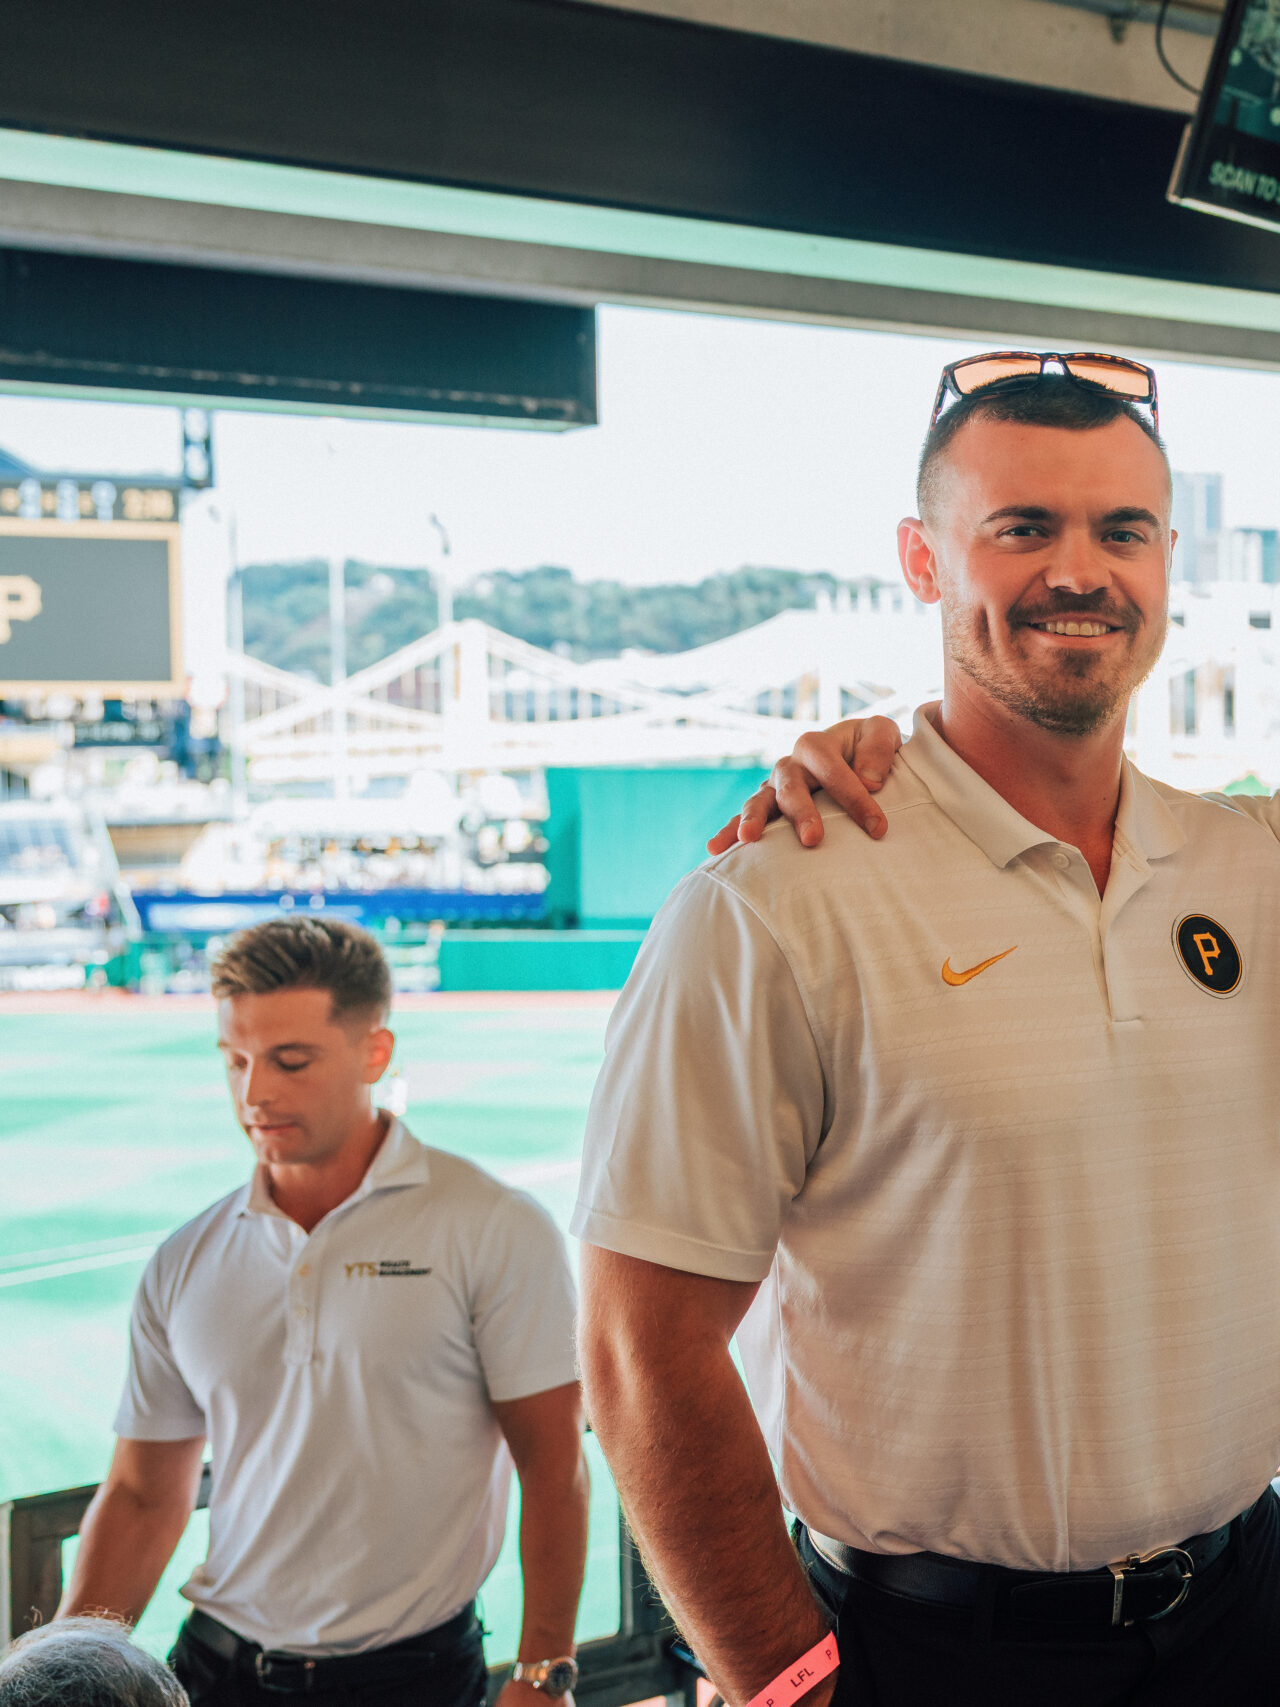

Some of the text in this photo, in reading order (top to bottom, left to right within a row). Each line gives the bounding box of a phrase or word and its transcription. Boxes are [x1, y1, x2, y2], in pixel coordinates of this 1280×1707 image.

[1209, 160, 1257, 195] SCAN
[1255, 174, 1278, 201] TO
[1193, 931, 1221, 976] P
[344, 1261, 377, 1280] YTS
[790, 1668, 814, 1687] LFL
